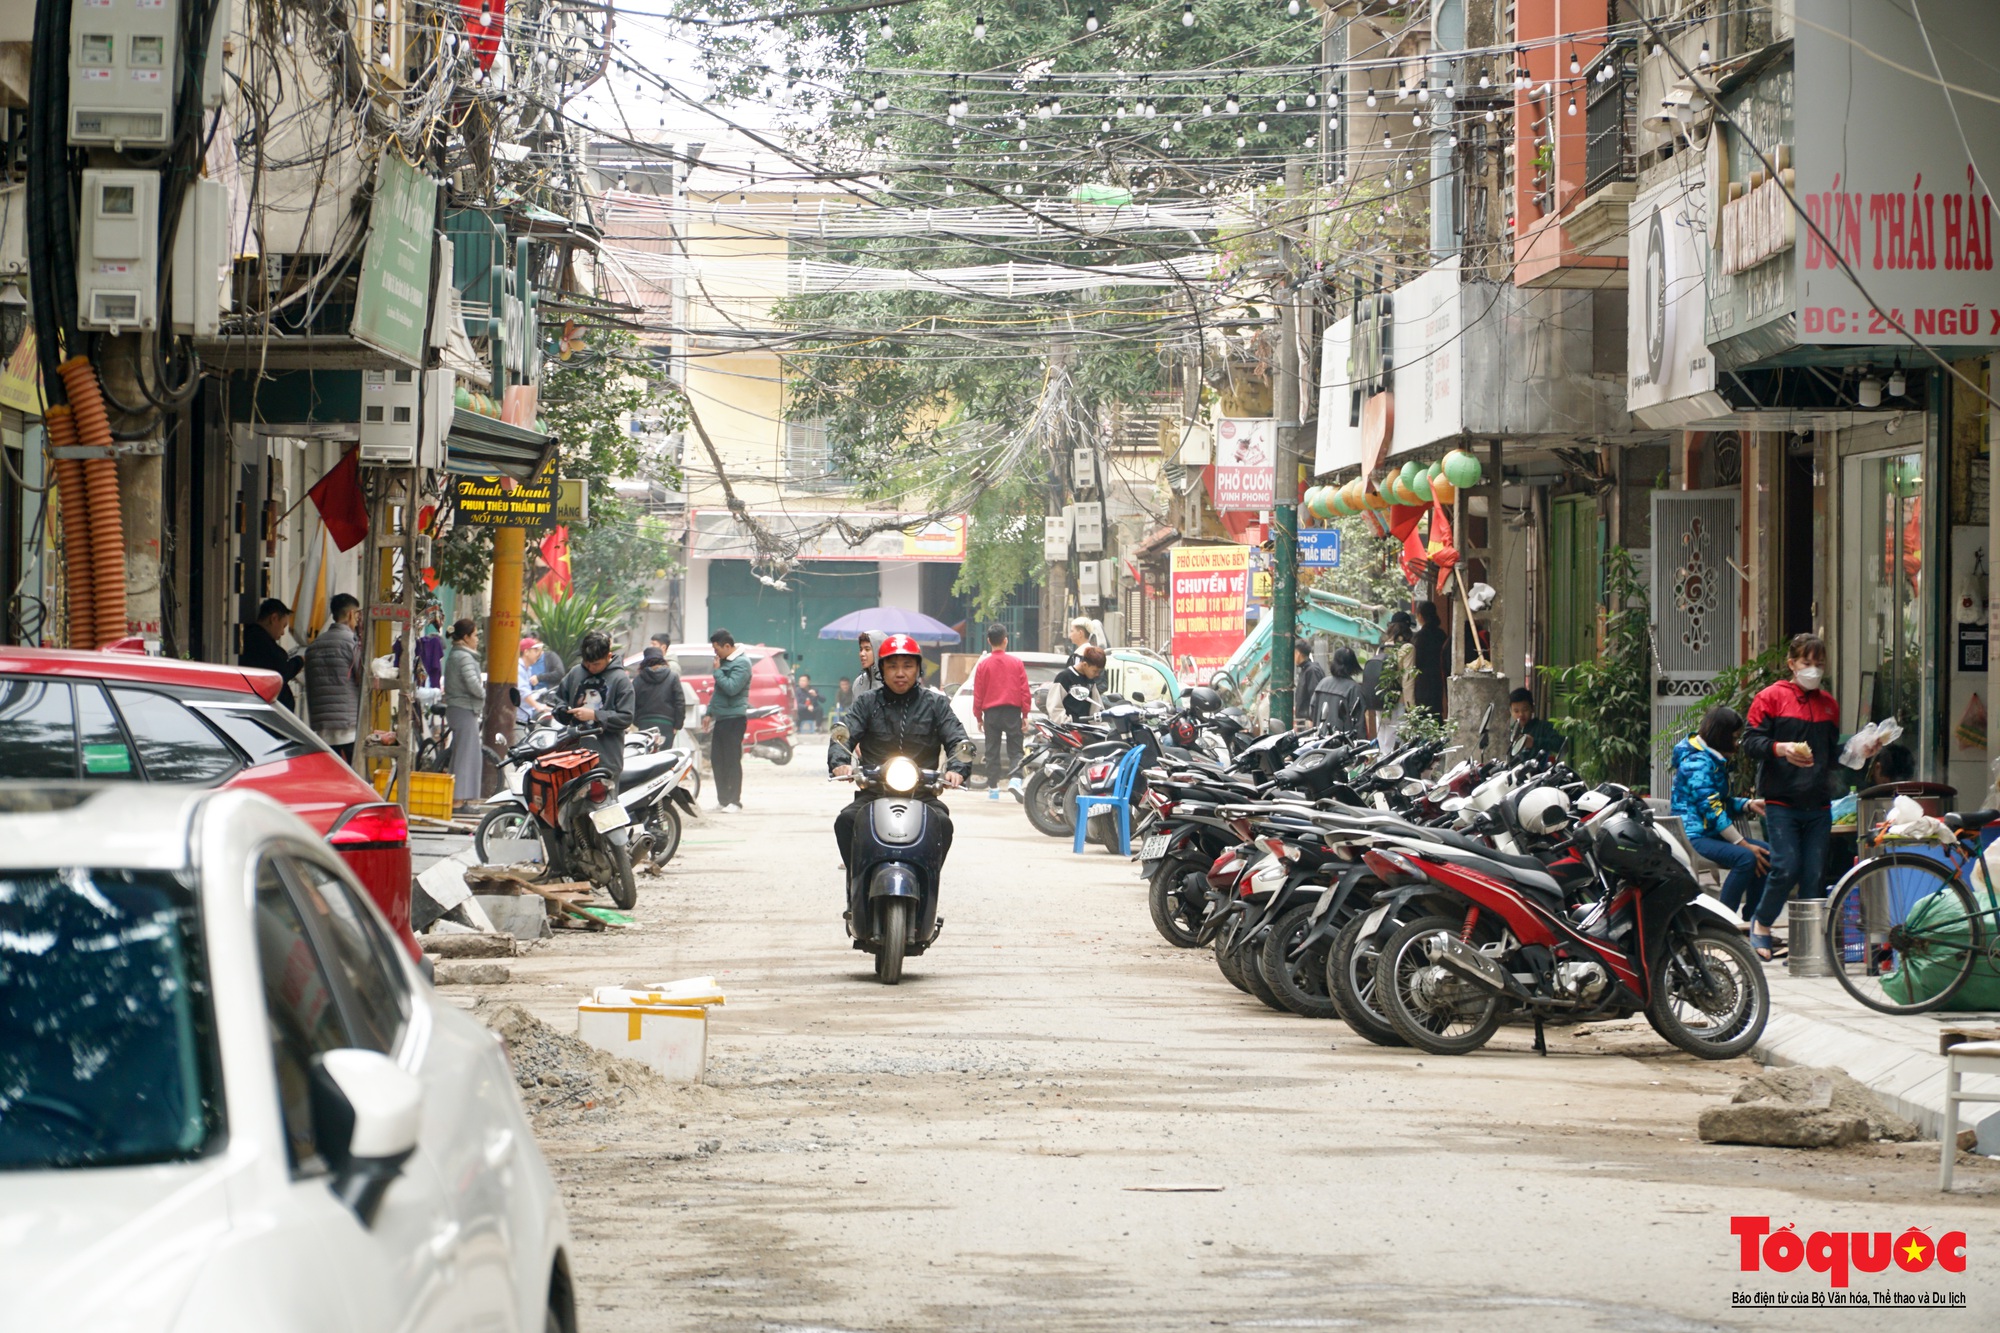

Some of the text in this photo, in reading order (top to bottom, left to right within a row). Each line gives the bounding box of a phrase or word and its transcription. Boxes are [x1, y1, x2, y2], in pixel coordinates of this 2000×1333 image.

[1805, 172, 1862, 270] BÚN
[1870, 172, 1936, 270] THÁI
[1943, 163, 1993, 271] HẢI
[1868, 308, 1906, 335] 24
[1914, 303, 1979, 335] NGŨ
[1218, 468, 1273, 491] PHỞ CUỐN
[458, 482, 550, 499] Thanh Thanh
[1221, 492, 1270, 502] VINH PHONG
[460, 499, 485, 511] PHUN
[487, 500, 508, 512] THÊU
[537, 501, 551, 513] MỸ
[515, 516, 541, 526] NAIL
[1297, 533, 1318, 543] PHỐ
[1176, 572, 1227, 594] CHUYỂN
